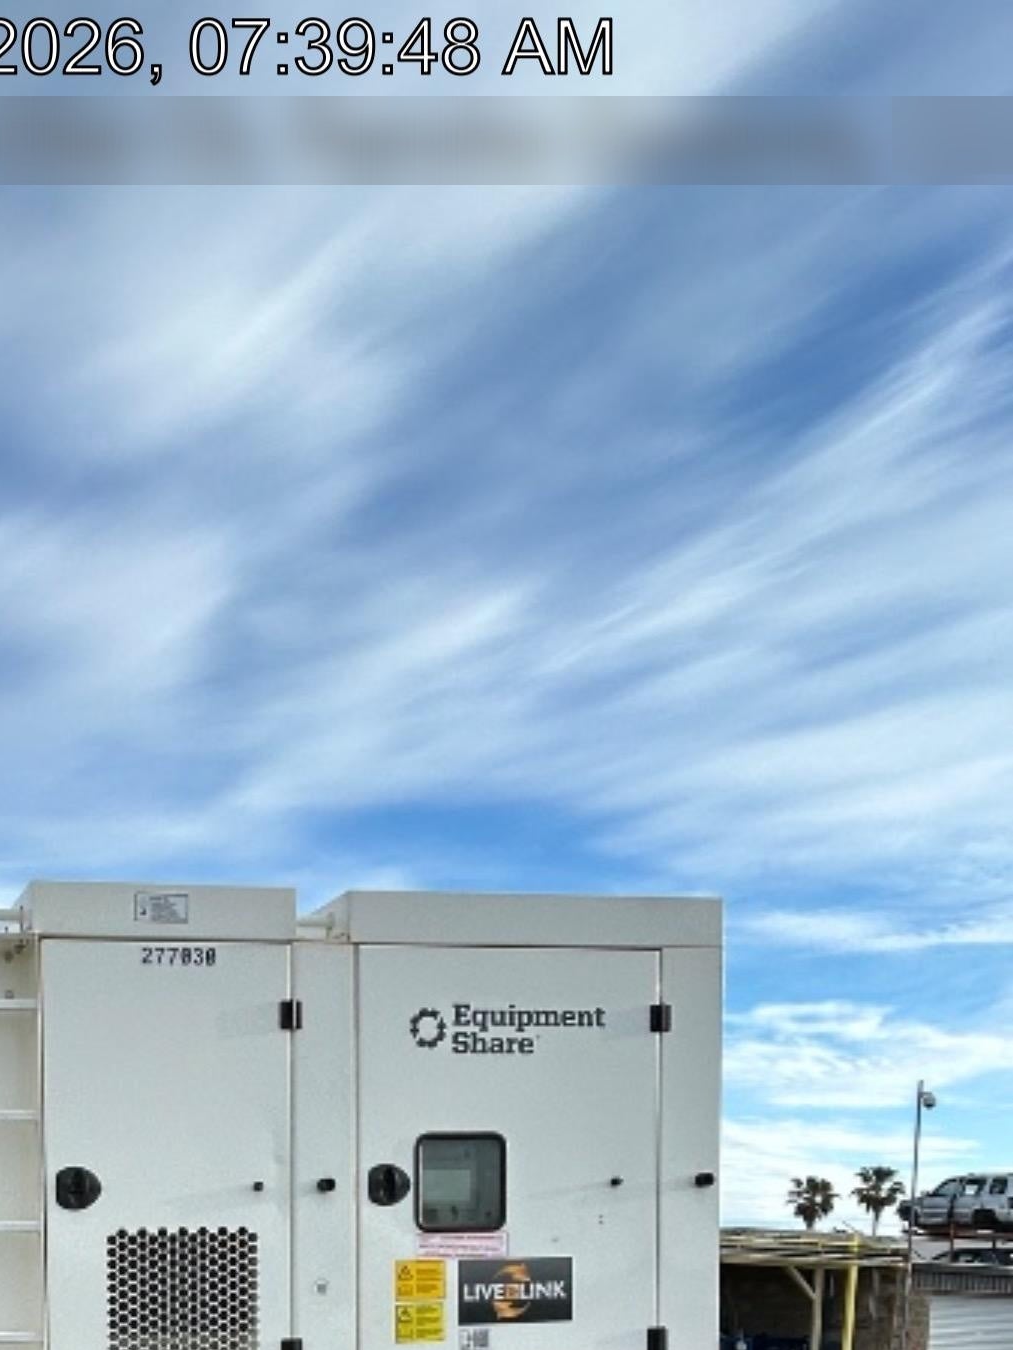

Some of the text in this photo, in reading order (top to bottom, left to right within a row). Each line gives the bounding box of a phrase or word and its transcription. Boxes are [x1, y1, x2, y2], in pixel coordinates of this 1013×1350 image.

[141, 947, 217, 967] 277030
[452, 1003, 606, 1032] Equipment
[452, 1031, 535, 1054] Share
